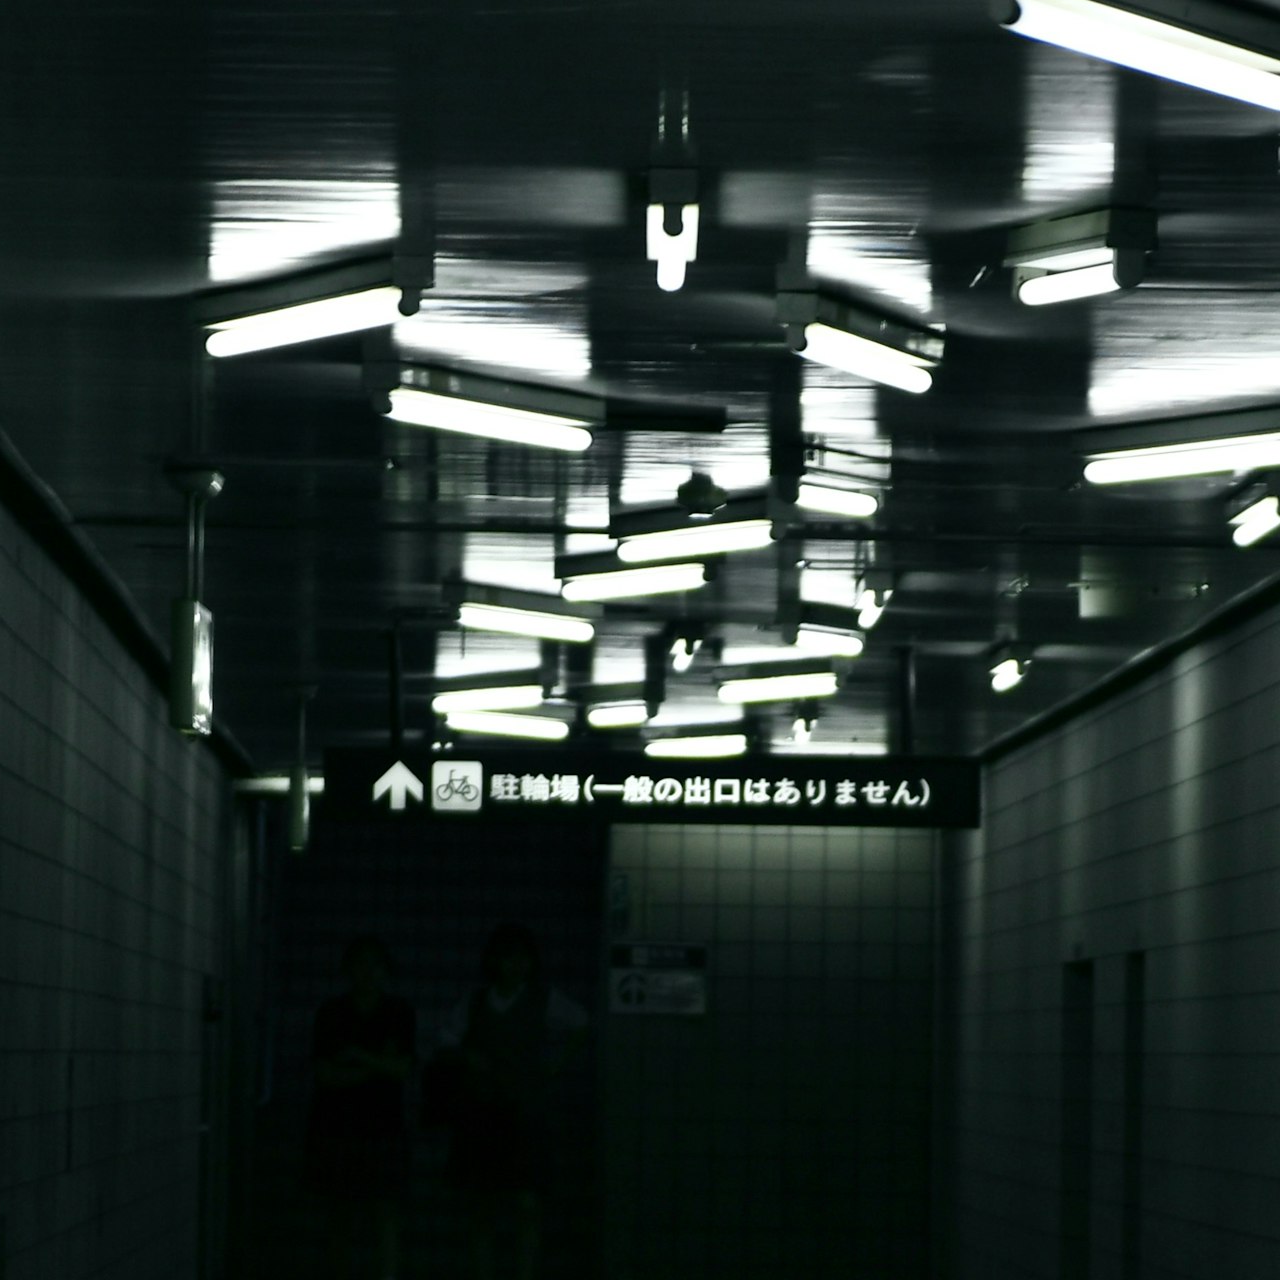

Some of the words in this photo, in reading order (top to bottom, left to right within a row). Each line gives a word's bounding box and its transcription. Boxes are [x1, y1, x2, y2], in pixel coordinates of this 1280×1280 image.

[490, 773, 930, 806] 駐輪場(一般の出口はありません)
